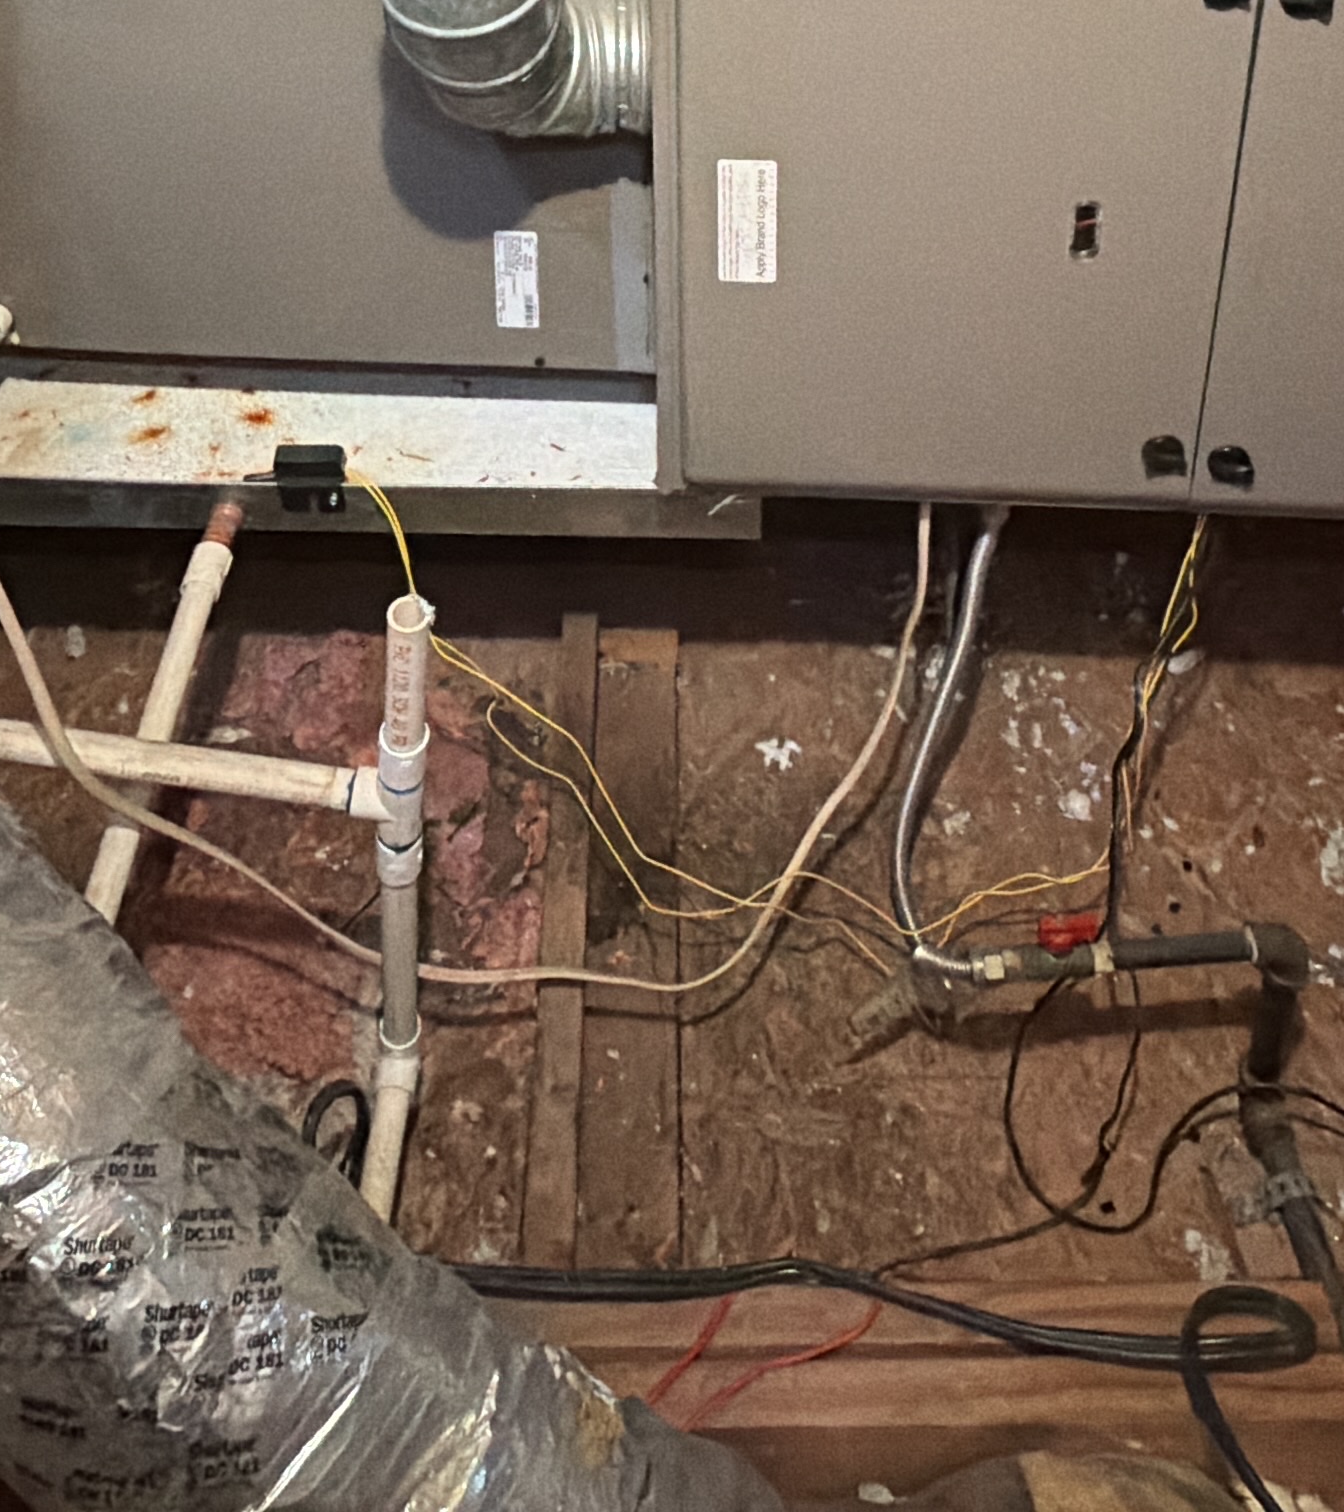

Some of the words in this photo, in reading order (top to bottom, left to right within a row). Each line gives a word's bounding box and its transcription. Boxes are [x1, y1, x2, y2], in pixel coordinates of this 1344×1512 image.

[756, 168, 766, 193] Here
[756, 195, 767, 219] Logo
[756, 221, 766, 250] Brand
[756, 252, 767, 278] Apply
